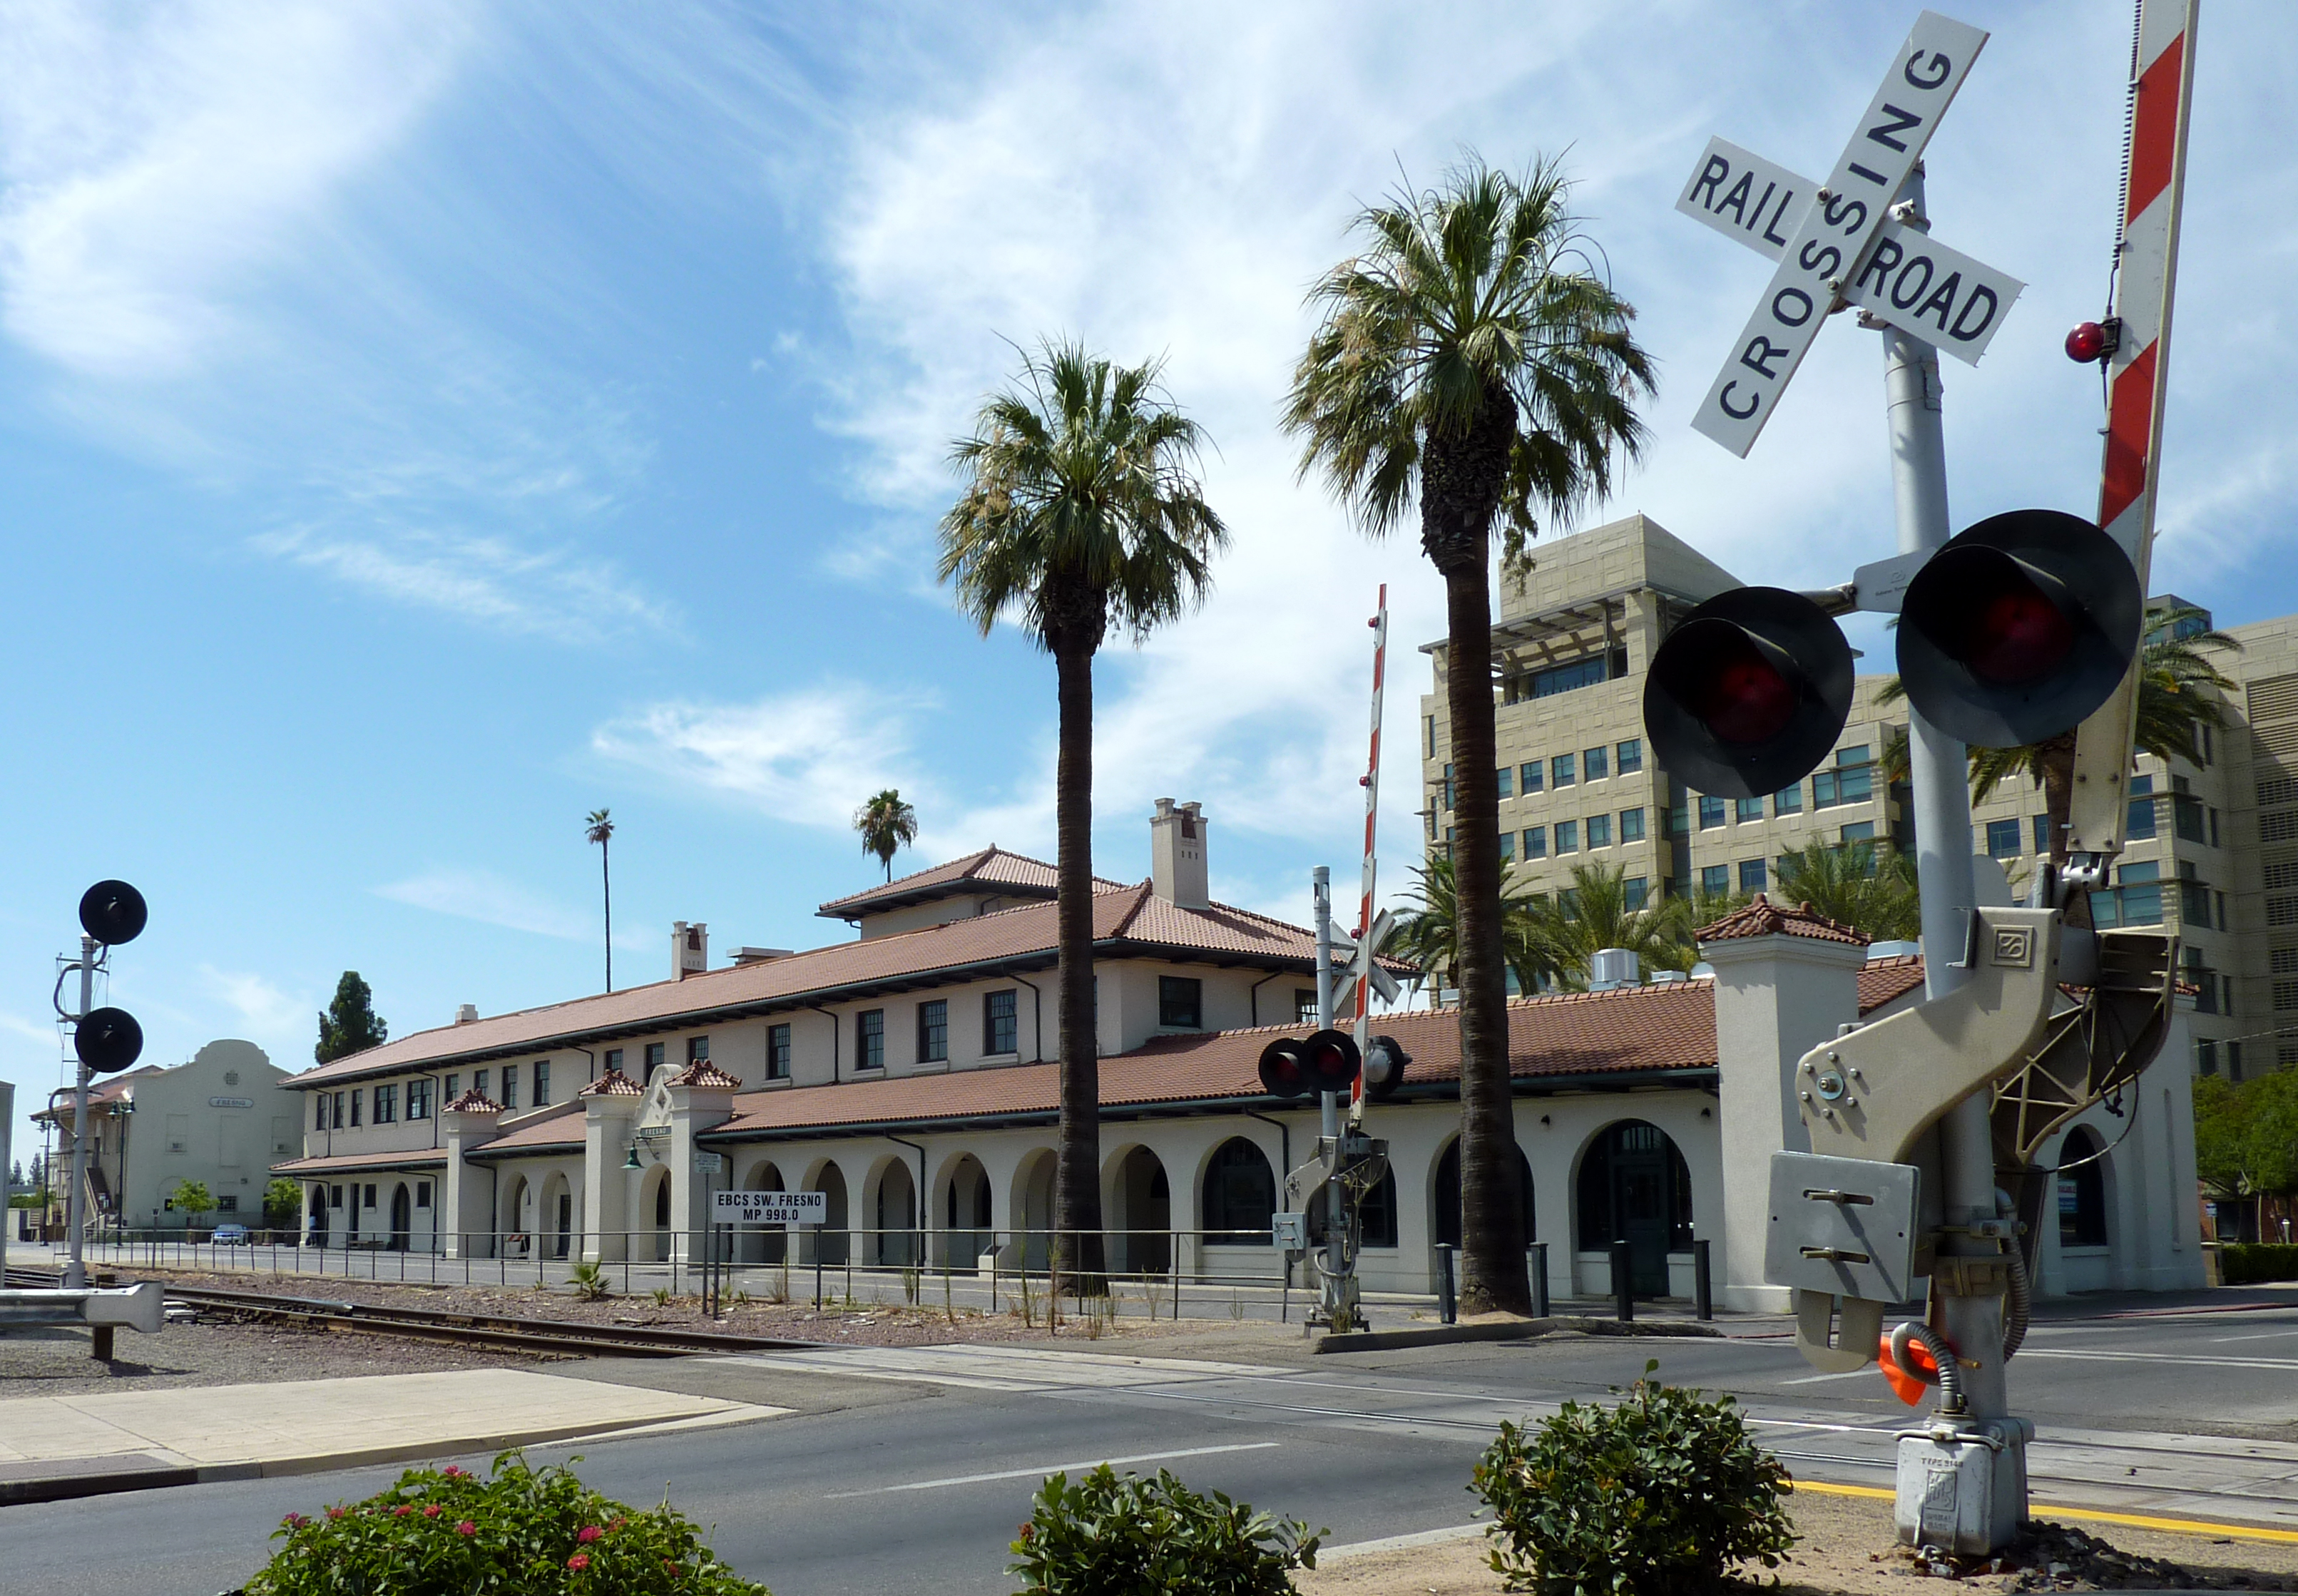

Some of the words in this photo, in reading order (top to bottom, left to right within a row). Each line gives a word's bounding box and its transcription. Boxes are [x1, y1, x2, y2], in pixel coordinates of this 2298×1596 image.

[1719, 48, 1952, 420] CROSSING
[1689, 153, 1793, 247] RAIL
[1855, 237, 1998, 342] ROAD
[645, 1127, 667, 1136] FRESNO
[718, 1194, 749, 1207] EBCS
[753, 1195, 774, 1207] SW.
[779, 1195, 821, 1207] FRESNO
[743, 1209, 762, 1221] MP
[766, 1209, 799, 1221] 998.0
